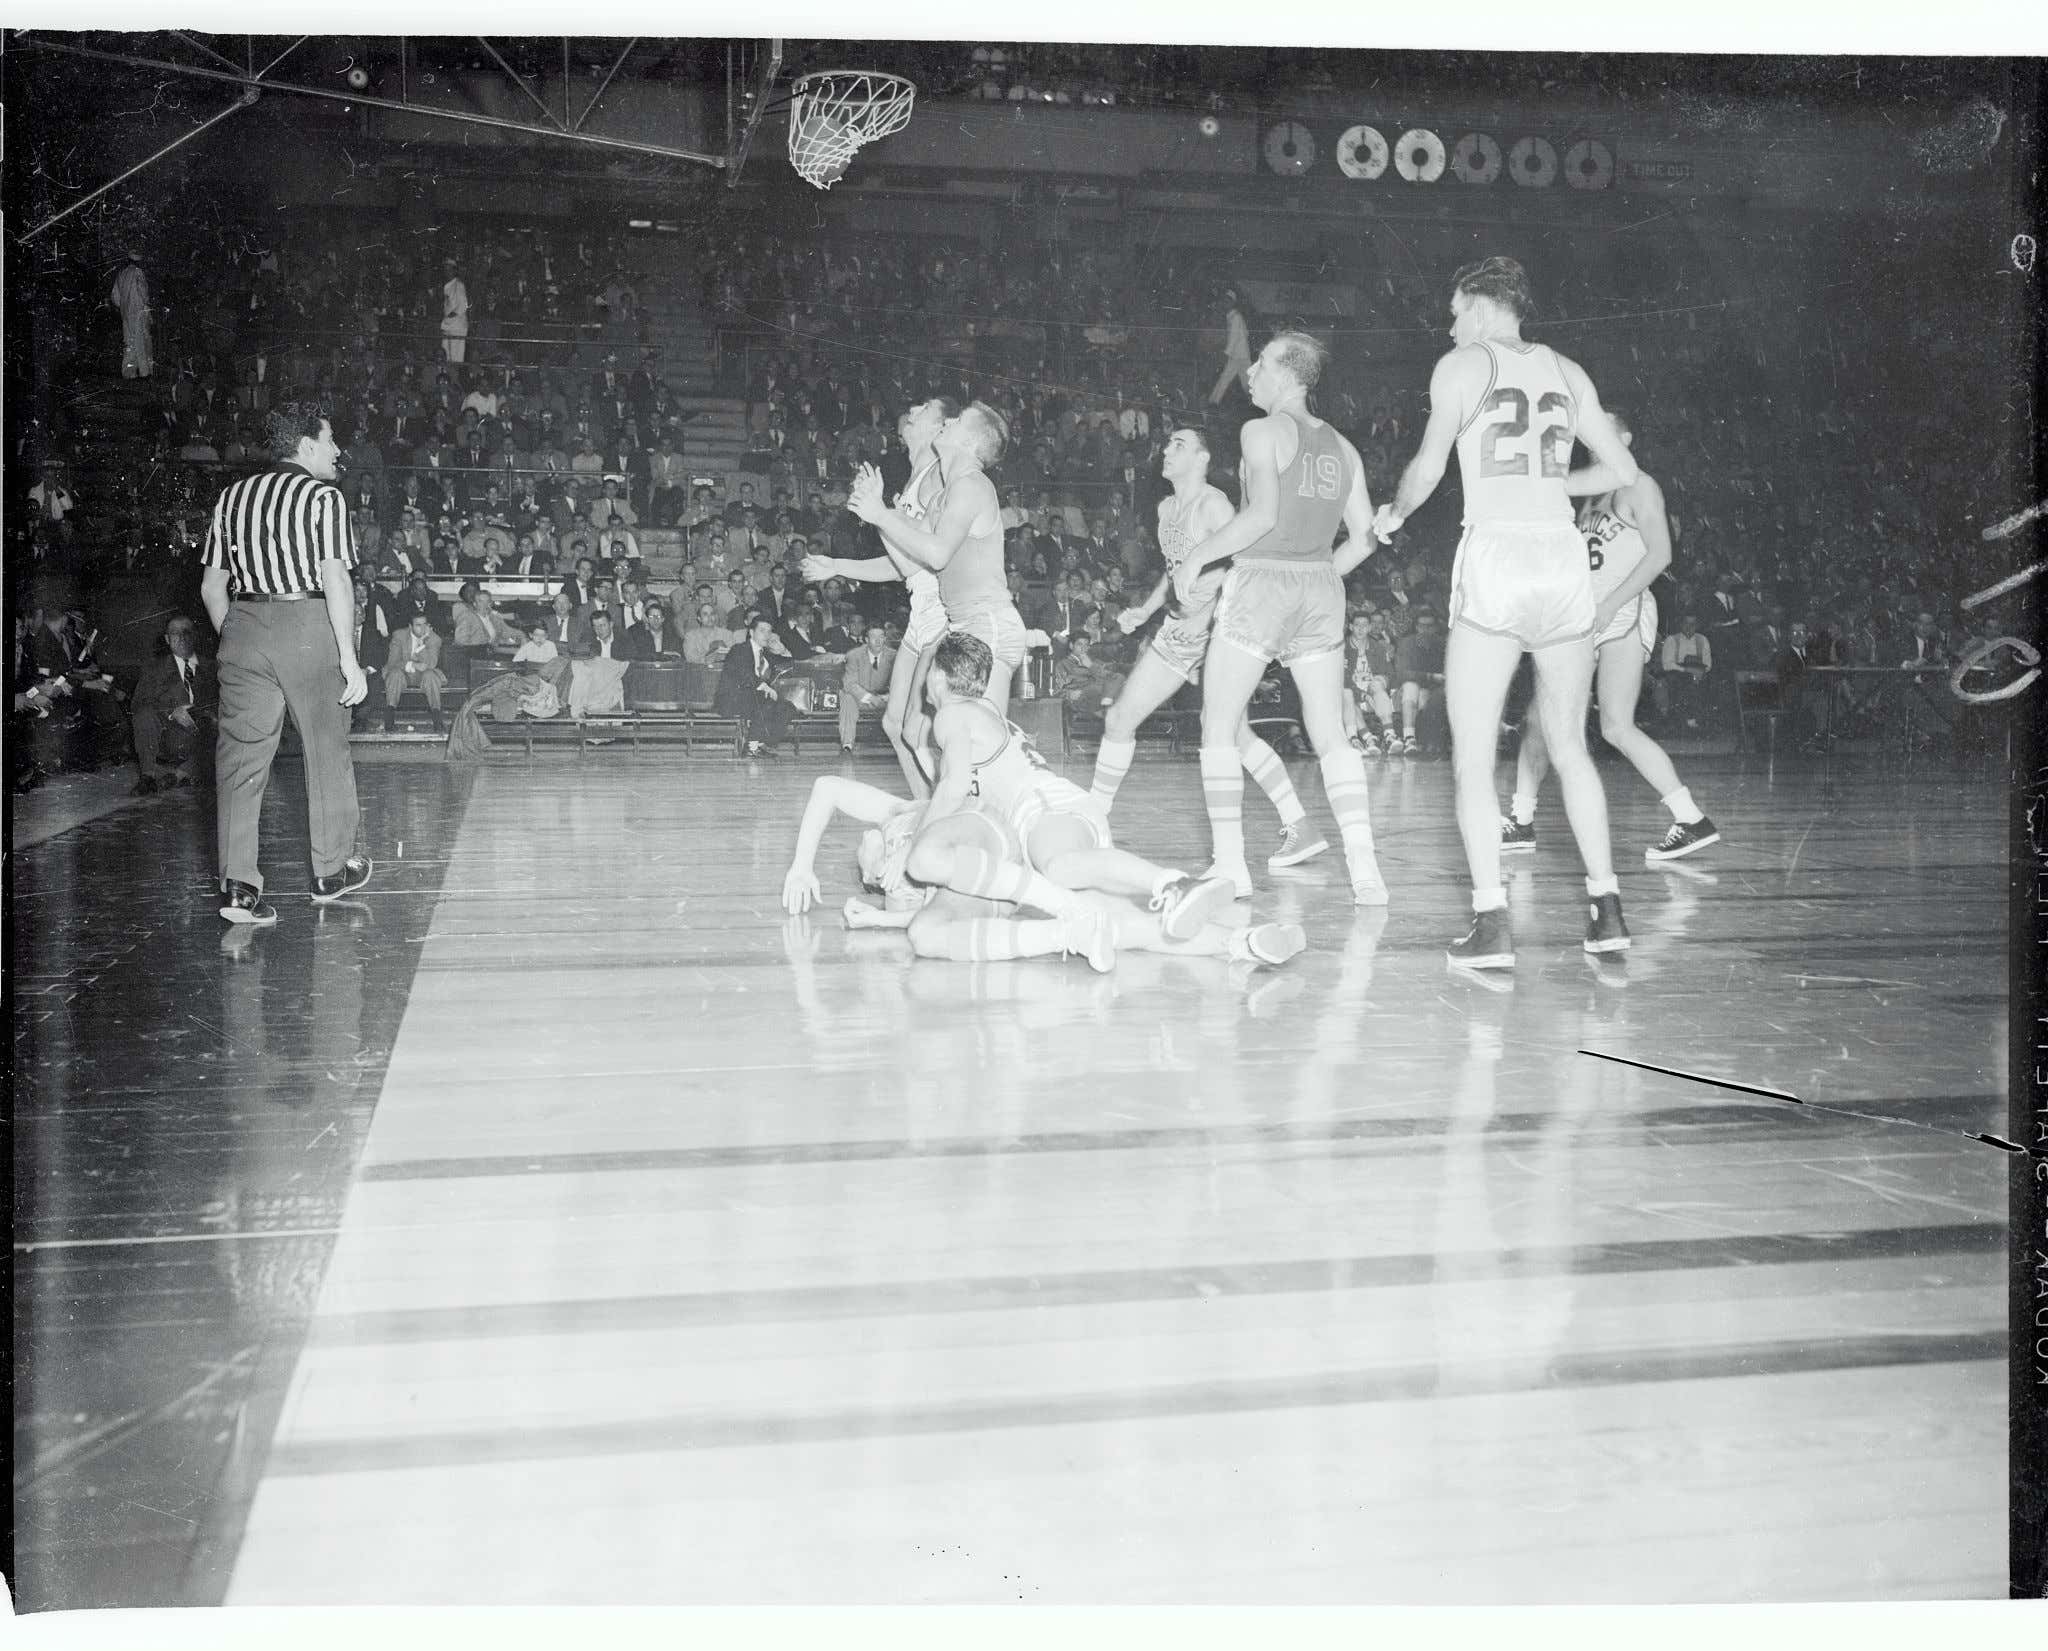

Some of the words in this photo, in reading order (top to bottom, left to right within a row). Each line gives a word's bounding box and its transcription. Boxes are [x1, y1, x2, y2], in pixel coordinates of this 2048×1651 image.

[1633, 163, 1665, 177] TIME
[1479, 387, 1571, 479] 22
[1298, 452, 1342, 500] 19
